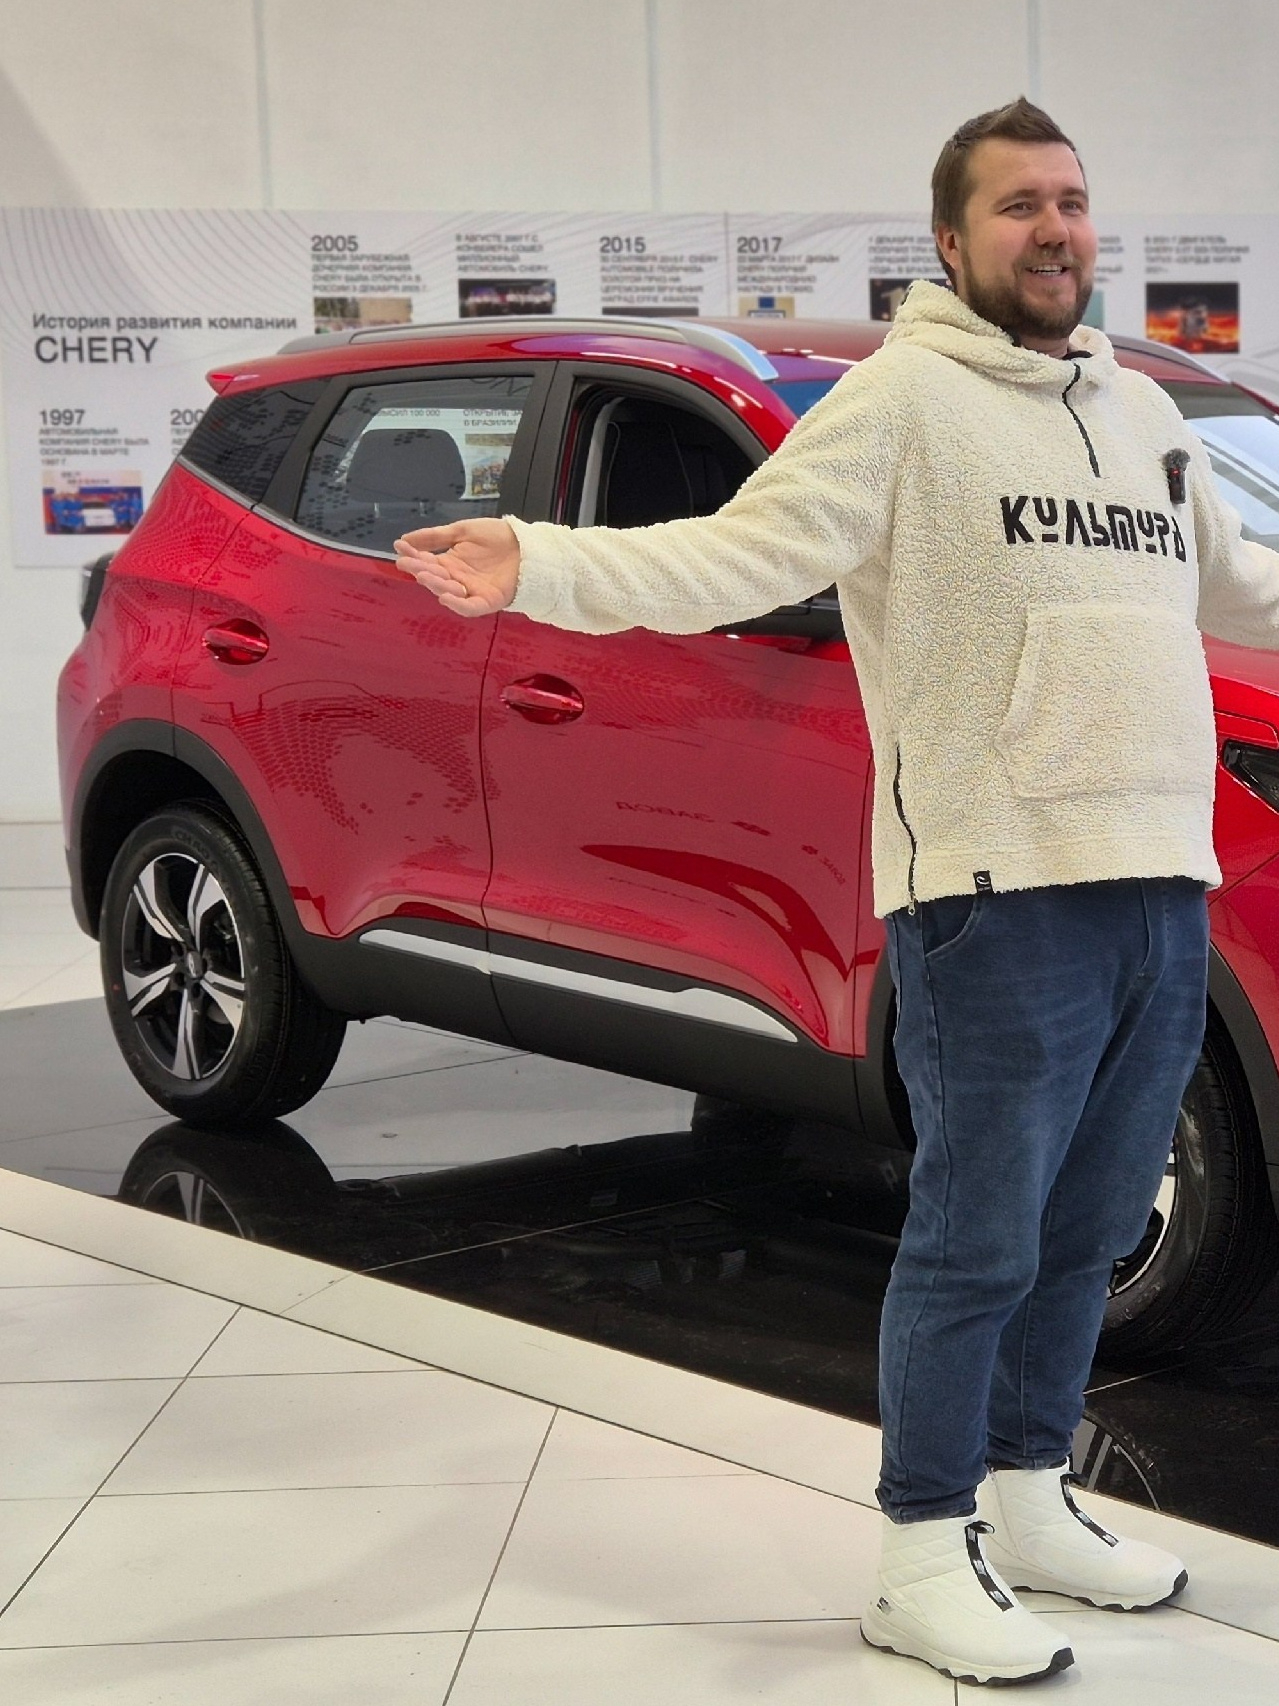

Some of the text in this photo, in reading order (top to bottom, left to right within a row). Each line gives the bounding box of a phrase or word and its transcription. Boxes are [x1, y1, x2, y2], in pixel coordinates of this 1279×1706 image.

[311, 235, 358, 252] 2005
[599, 236, 646, 253] 2015
[737, 236, 783, 253] 2017
[33, 314, 297, 332] История развития компании
[34, 336, 159, 363] CHERY
[39, 408, 85, 426] 1997
